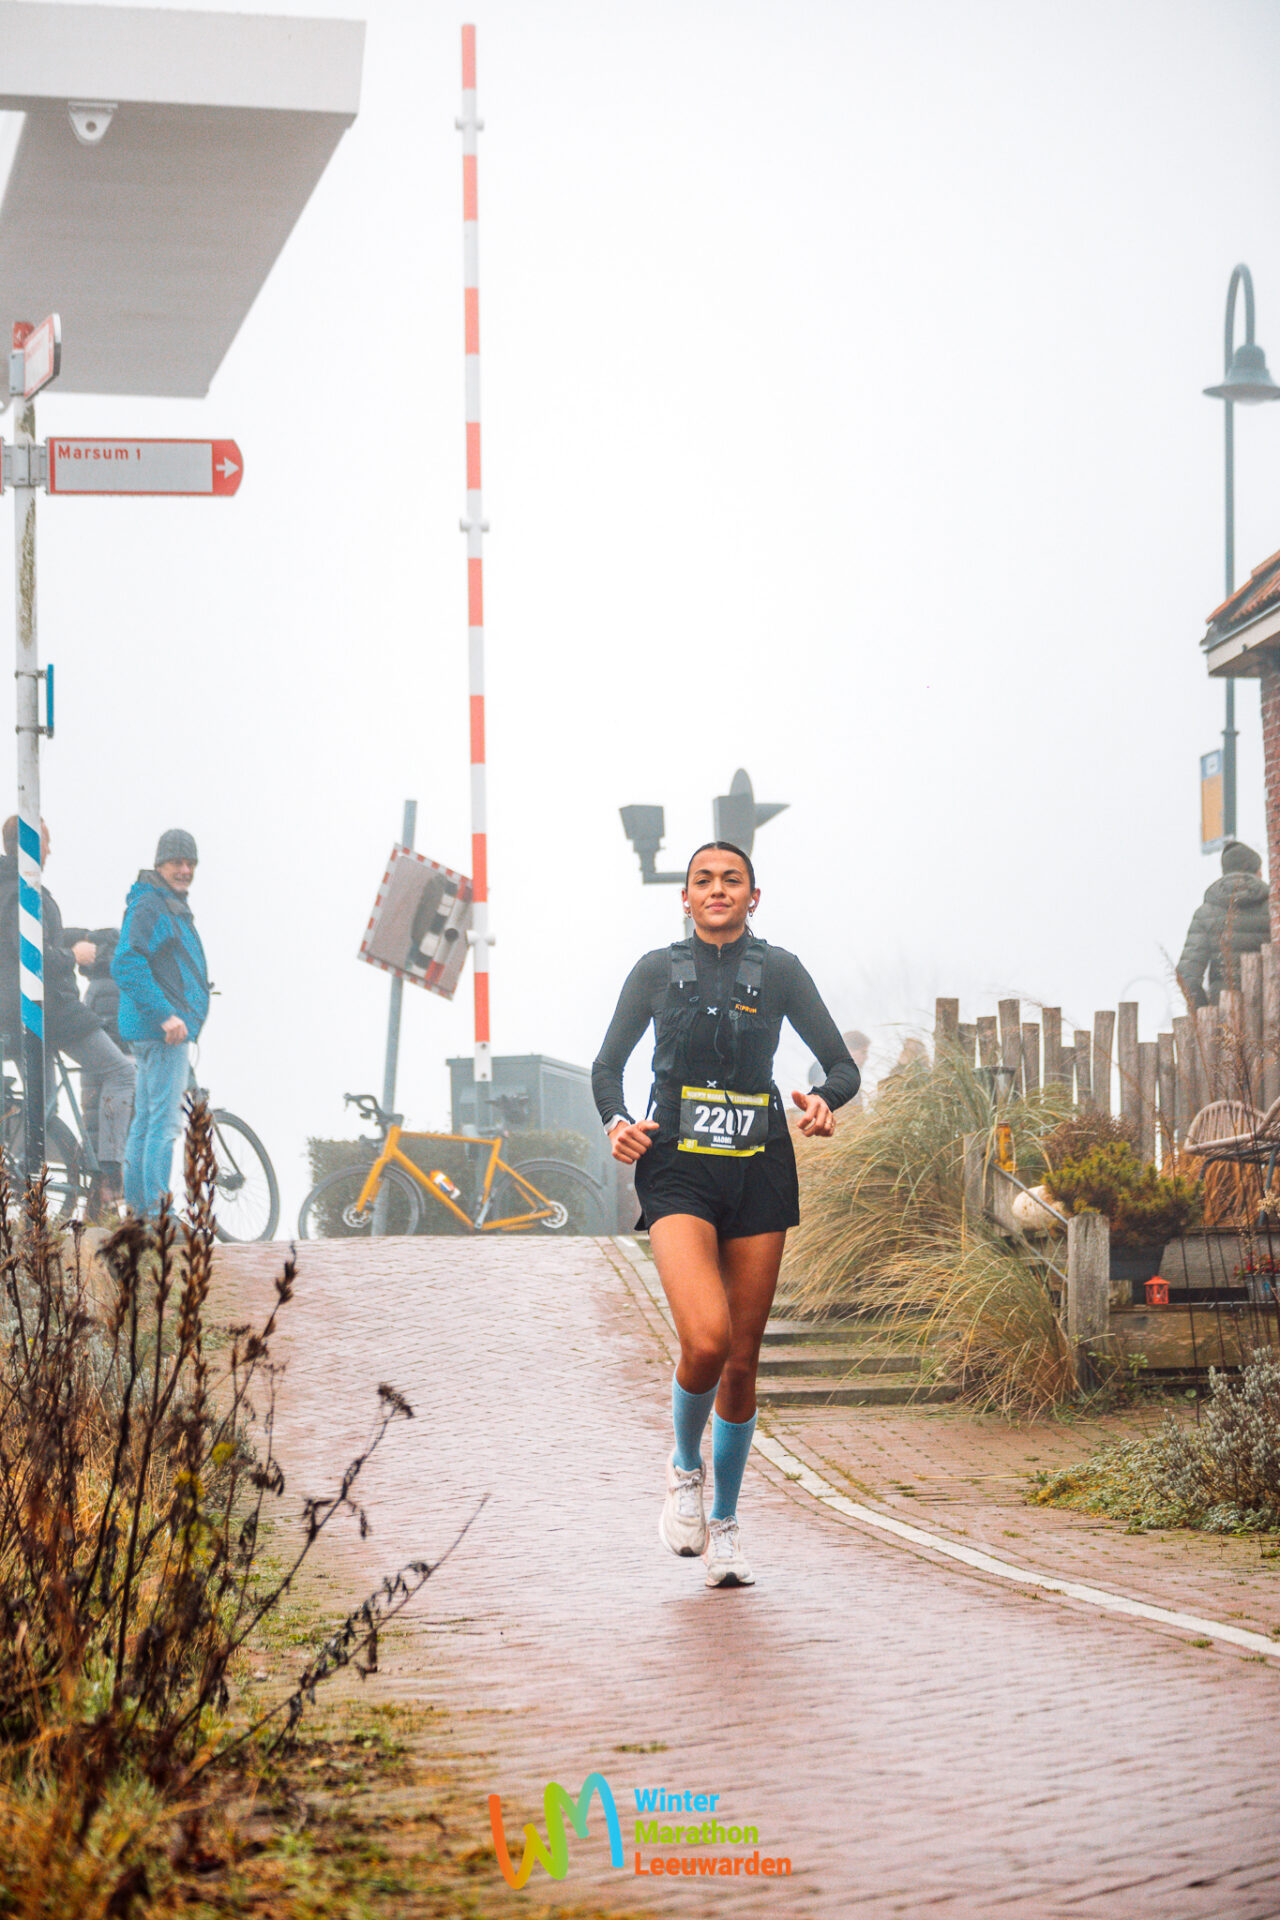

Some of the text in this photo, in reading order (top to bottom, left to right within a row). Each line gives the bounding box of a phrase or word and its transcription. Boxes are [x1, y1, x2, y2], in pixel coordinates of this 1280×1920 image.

[58, 445, 141, 460] Marsum 1
[693, 1105, 755, 1136] 2207
